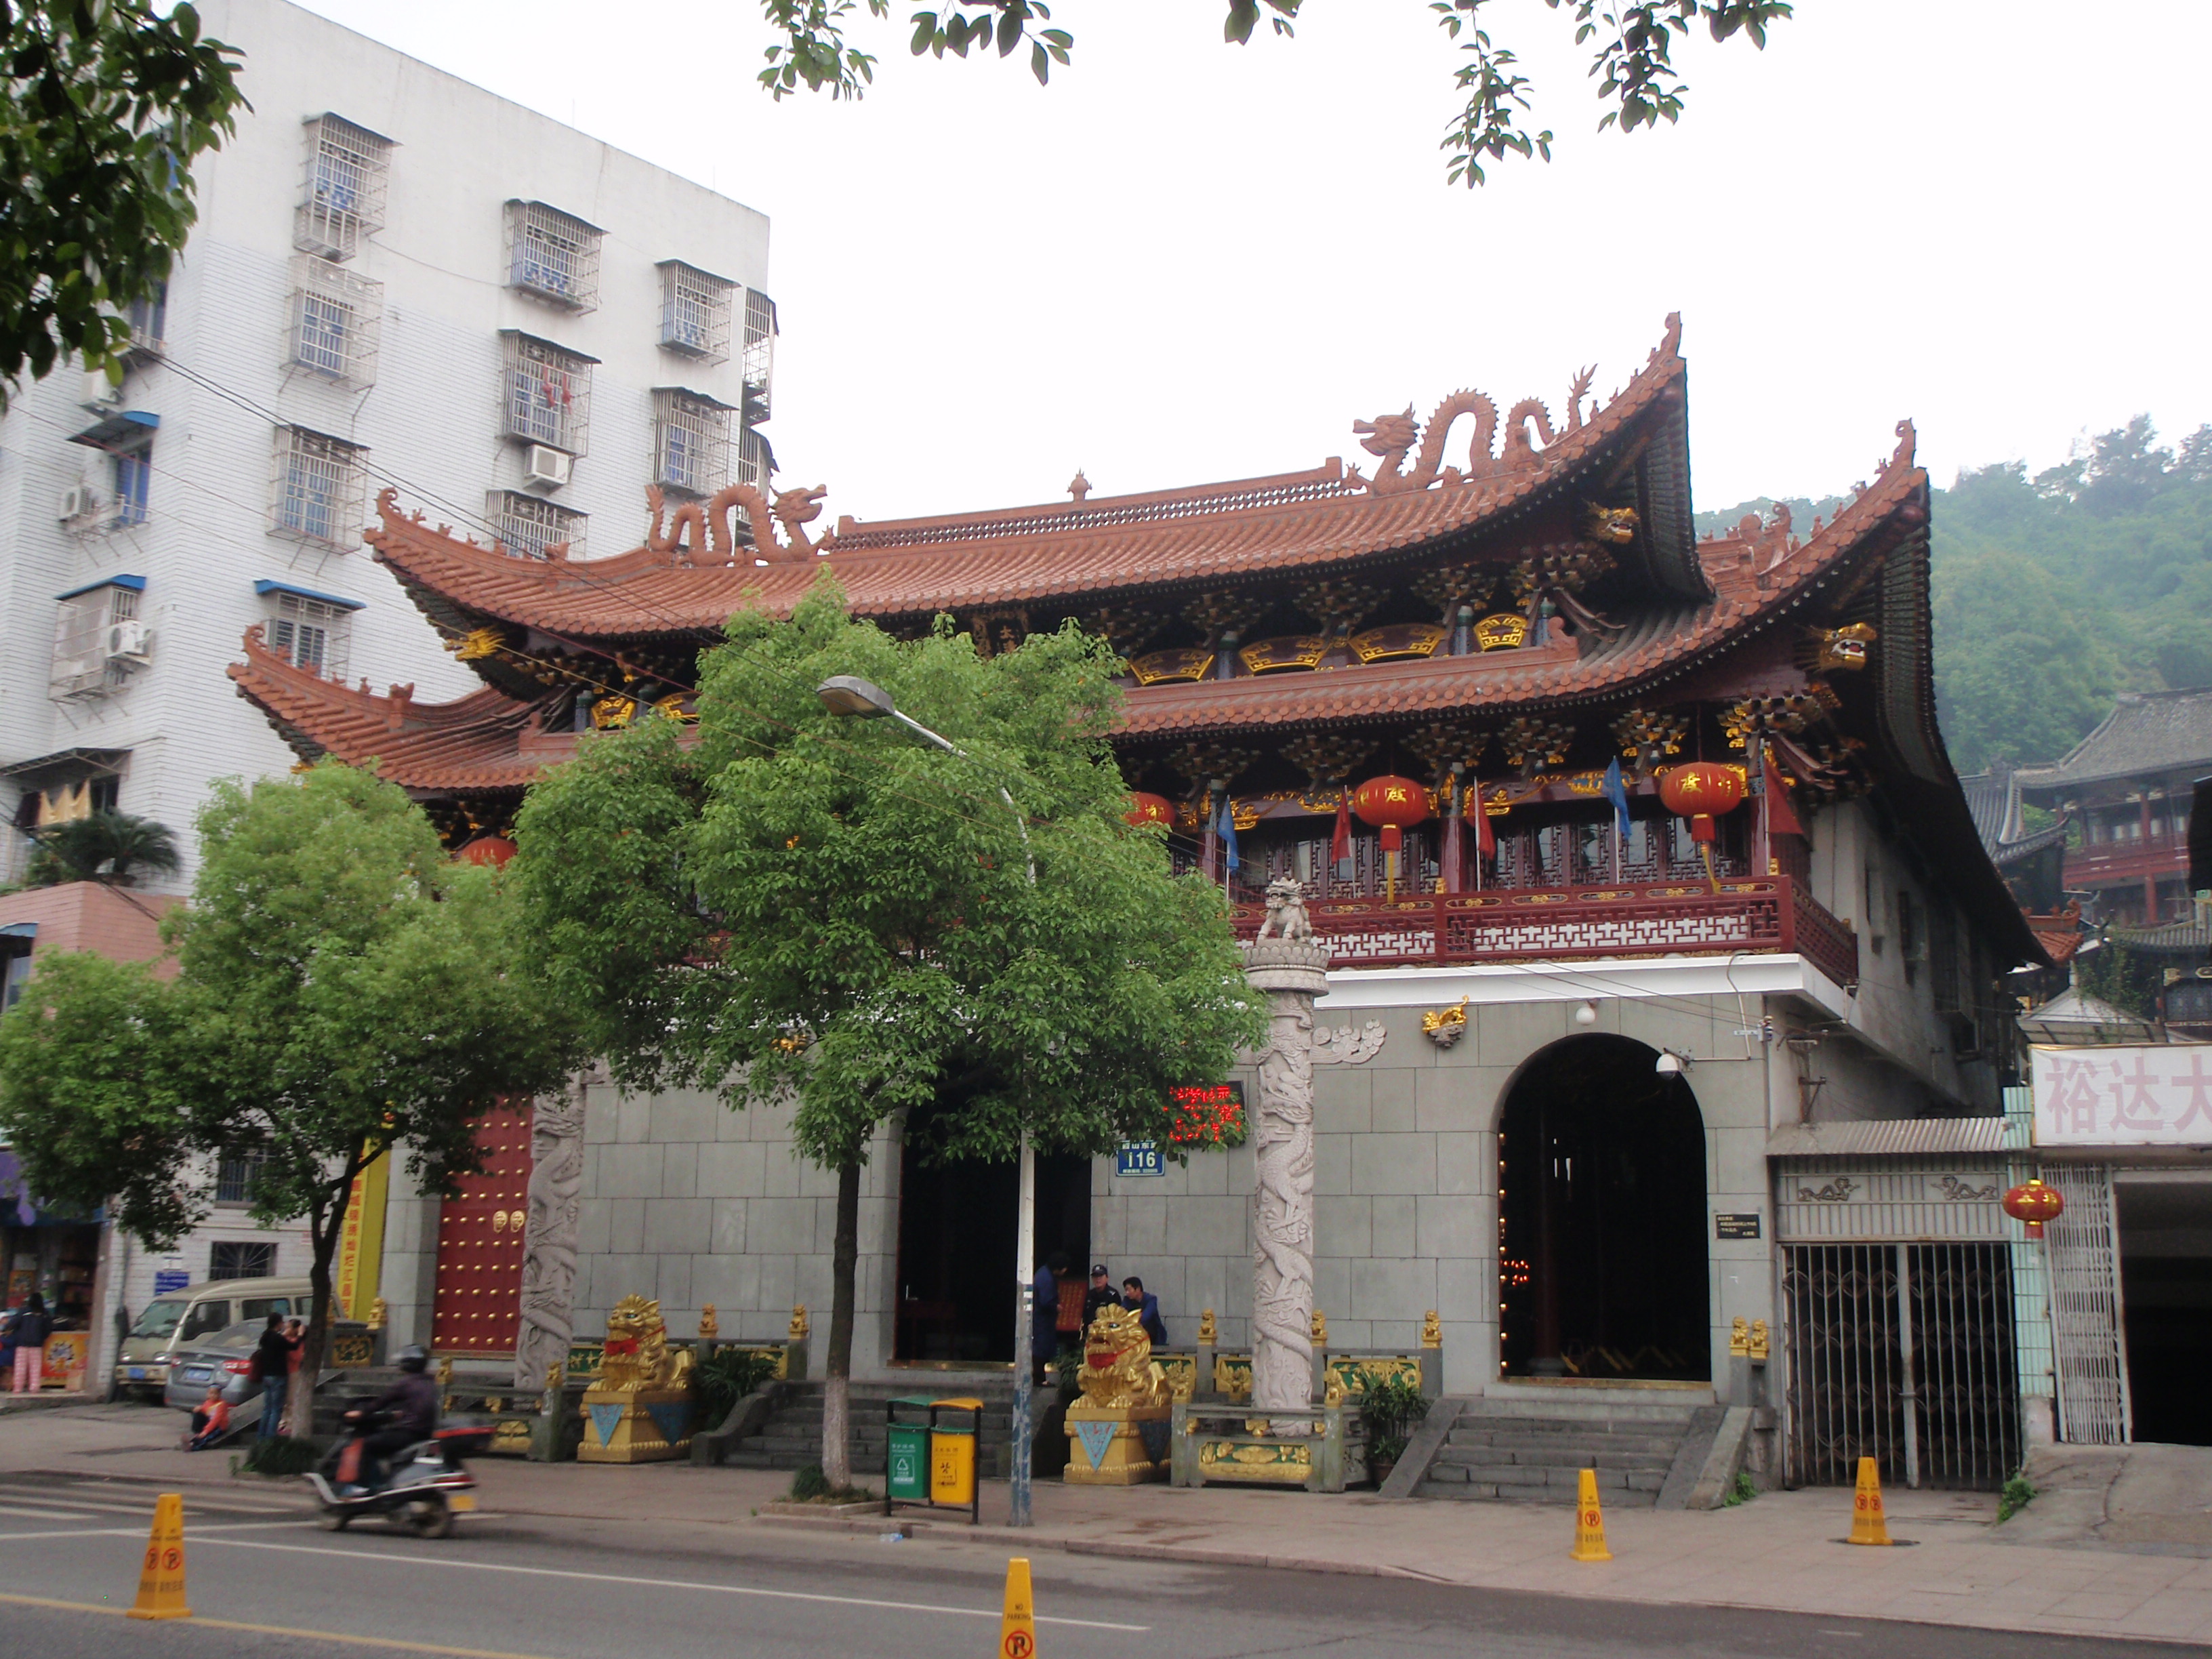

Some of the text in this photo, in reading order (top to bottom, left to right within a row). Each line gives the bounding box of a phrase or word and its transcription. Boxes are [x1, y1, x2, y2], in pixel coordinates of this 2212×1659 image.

[2045, 1054, 2212, 1133] 裕达大
[1128, 1151, 1155, 1168] 116
